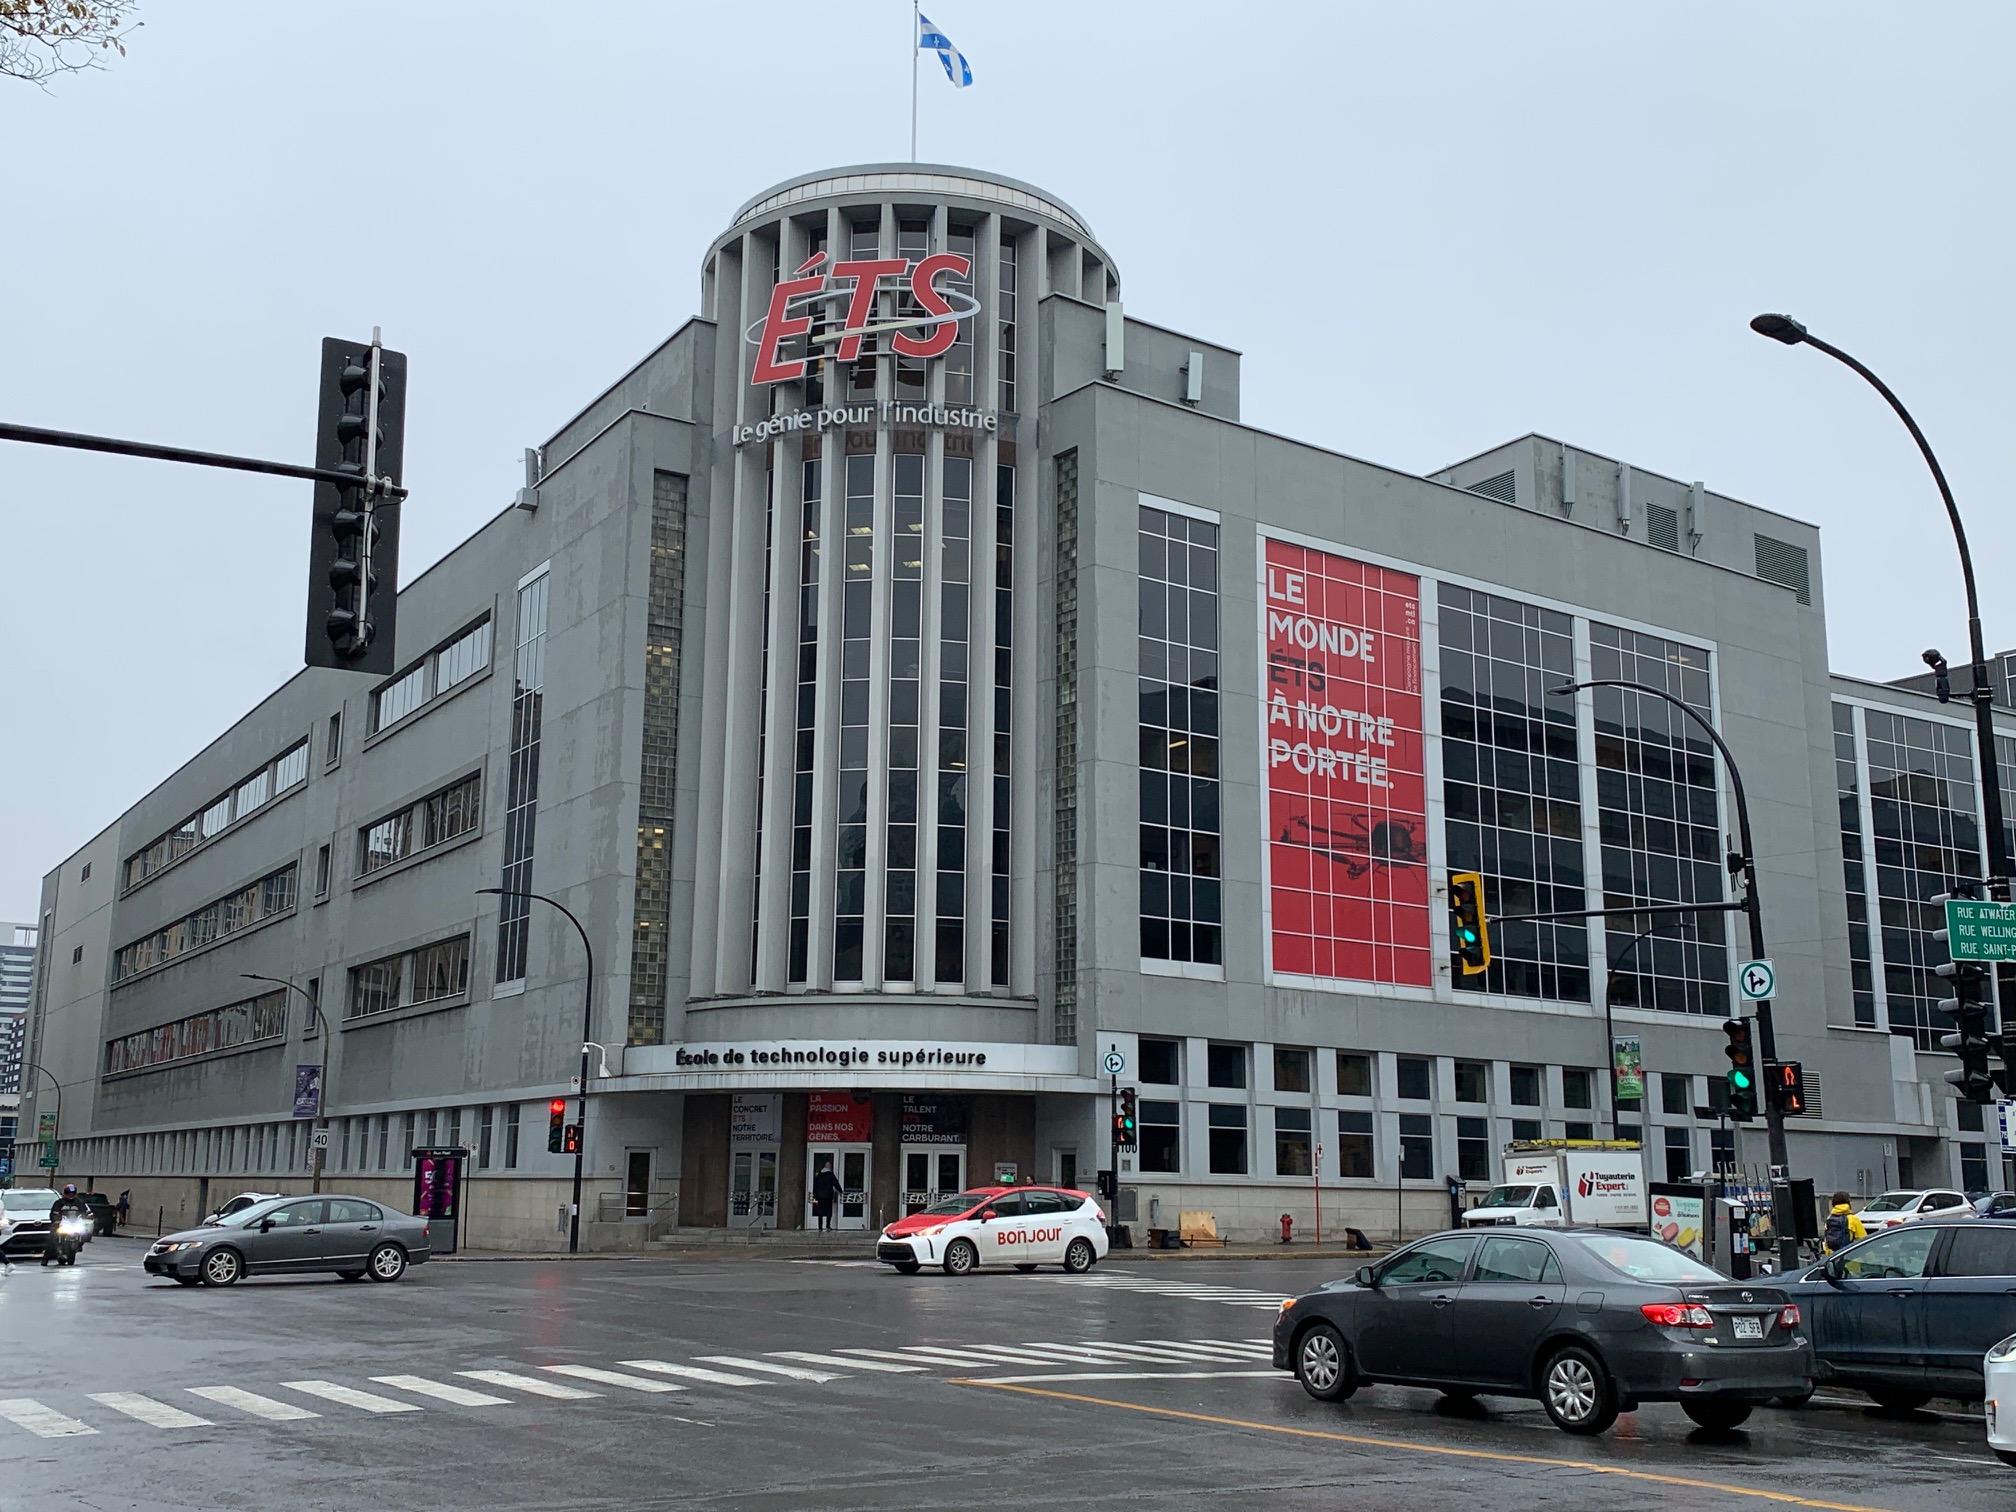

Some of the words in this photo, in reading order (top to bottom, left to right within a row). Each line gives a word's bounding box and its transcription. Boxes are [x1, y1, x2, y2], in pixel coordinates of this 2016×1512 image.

[751, 251, 971, 385] ÉTS
[756, 407, 812, 443] génie
[817, 405, 874, 433] pour
[882, 402, 998, 432] l'industrie
[1269, 568, 1304, 604] LE
[1269, 611, 1375, 663] MONDE
[1270, 688, 1291, 727] À
[1297, 700, 1395, 747] NOTRE
[1271, 739, 1395, 790] PORTÉE.
[1957, 907, 1975, 919] RUE
[1979, 908, 2015, 920] ATWATER
[1959, 925, 1976, 937] RUE
[1961, 942, 1978, 954] RUE
[675, 1047, 719, 1066] École
[723, 1048, 745, 1065] de
[750, 1047, 869, 1066] technologie
[877, 1048, 987, 1066] supérieure
[733, 1105, 768, 1113] CONCRET
[809, 1104, 848, 1112] PASSION
[903, 1105, 937, 1113] TALENT
[809, 1123, 833, 1131] DANS
[834, 1123, 854, 1131] NOS
[902, 1124, 934, 1132] NOTRE
[314, 1134, 328, 1146] 40
[1595, 1172, 1635, 1181] Tuyauterie
[1596, 1182, 1625, 1192] Expert
